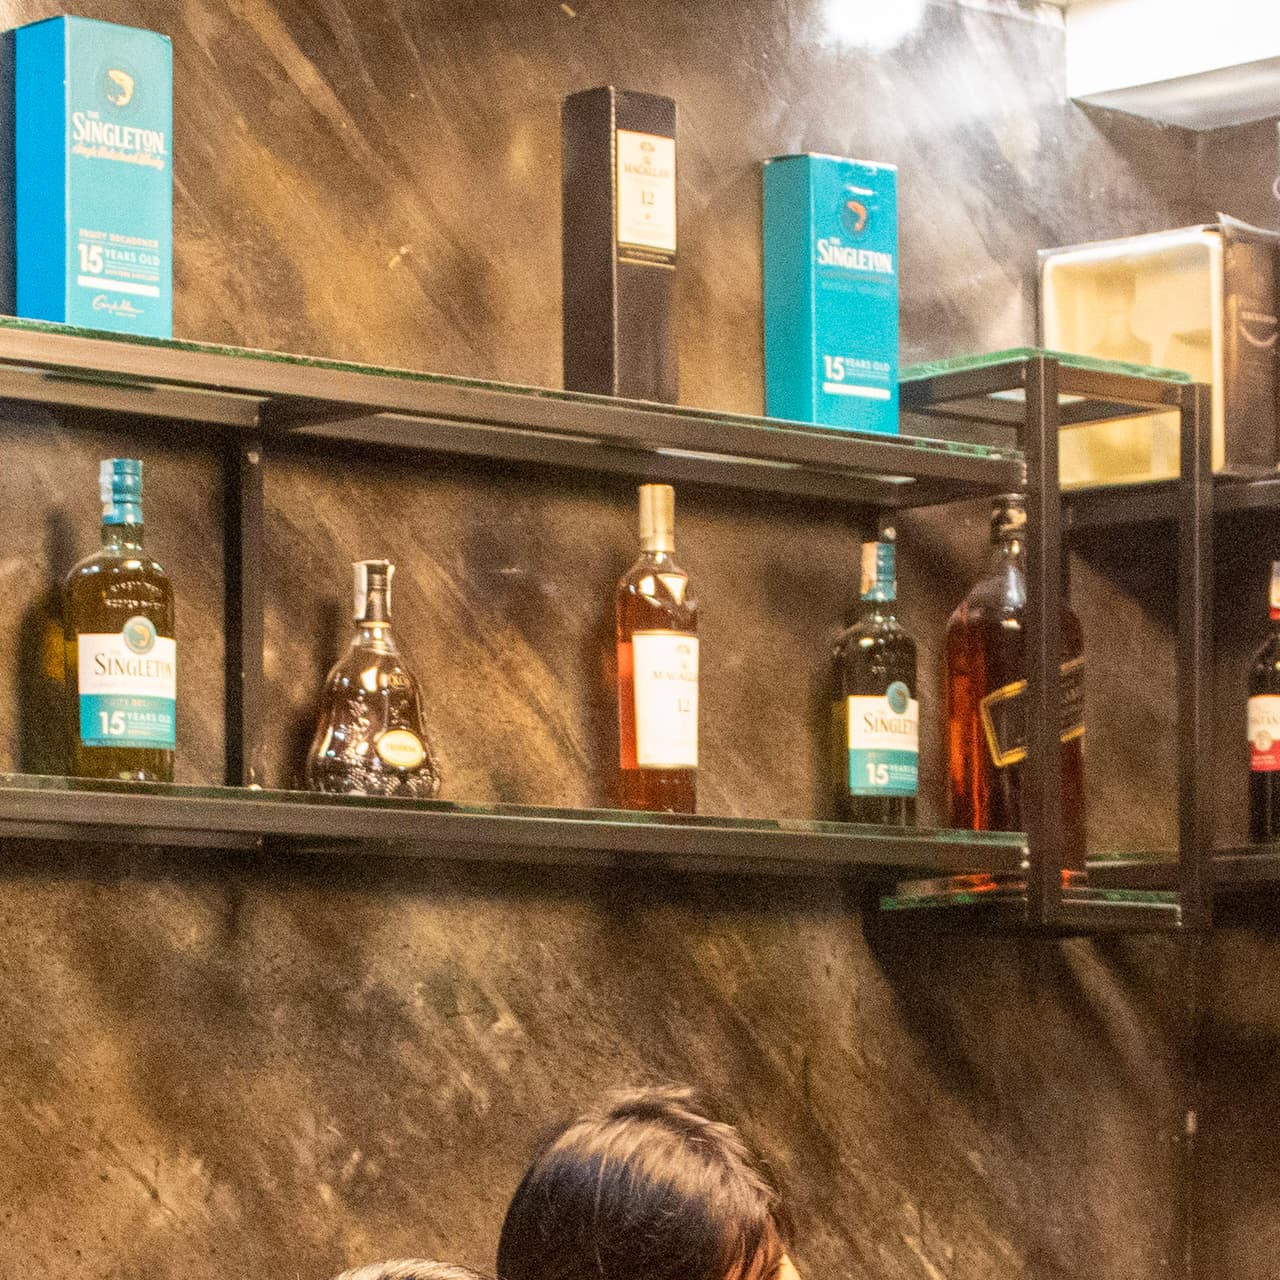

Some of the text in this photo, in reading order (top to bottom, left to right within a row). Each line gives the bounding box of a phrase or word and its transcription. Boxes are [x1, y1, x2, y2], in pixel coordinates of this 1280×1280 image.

[72, 111, 164, 154] SINGLETON
[77, 243, 103, 274] 15
[105, 249, 136, 263] YEARS
[823, 355, 845, 381] 15
[99, 711, 126, 735] 15
[866, 763, 889, 786] 15
